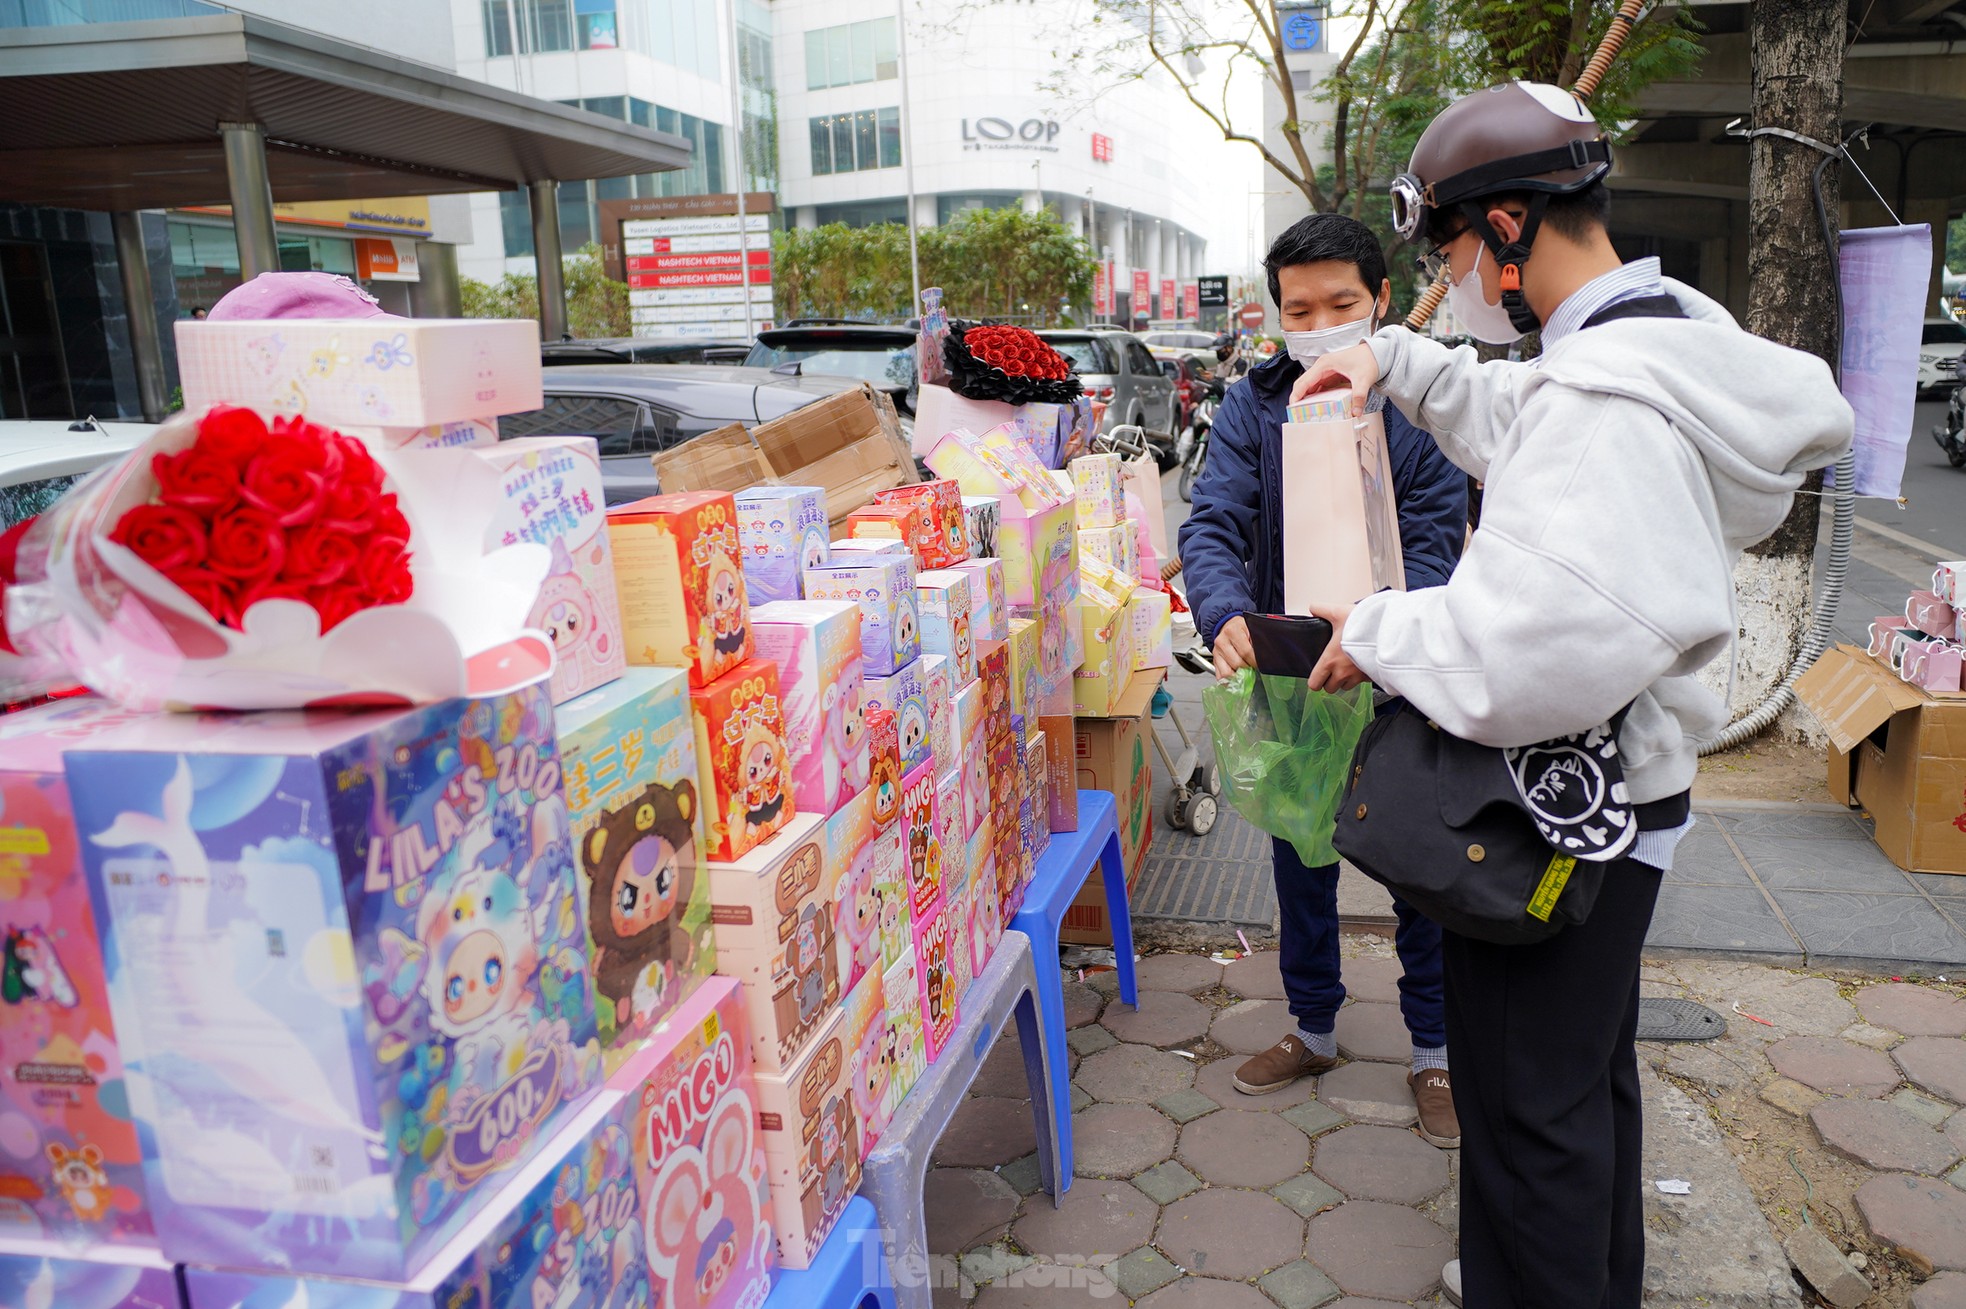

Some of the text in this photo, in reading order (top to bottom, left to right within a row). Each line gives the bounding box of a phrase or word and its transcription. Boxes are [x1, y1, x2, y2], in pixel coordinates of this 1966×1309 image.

[962, 117, 1060, 142] LOOP
[401, 256, 415, 265] ATM
[658, 255, 741, 267] NASHTECH VIETNAM
[659, 272, 742, 285] NASHTECH VIETNAM
[505, 457, 576, 498] BABY THREE
[495, 742, 561, 800] ZOO
[903, 767, 937, 820] MIGO
[921, 904, 949, 962] MIGO
[647, 1031, 735, 1169] MIGO
[583, 1181, 637, 1244] ZOO
